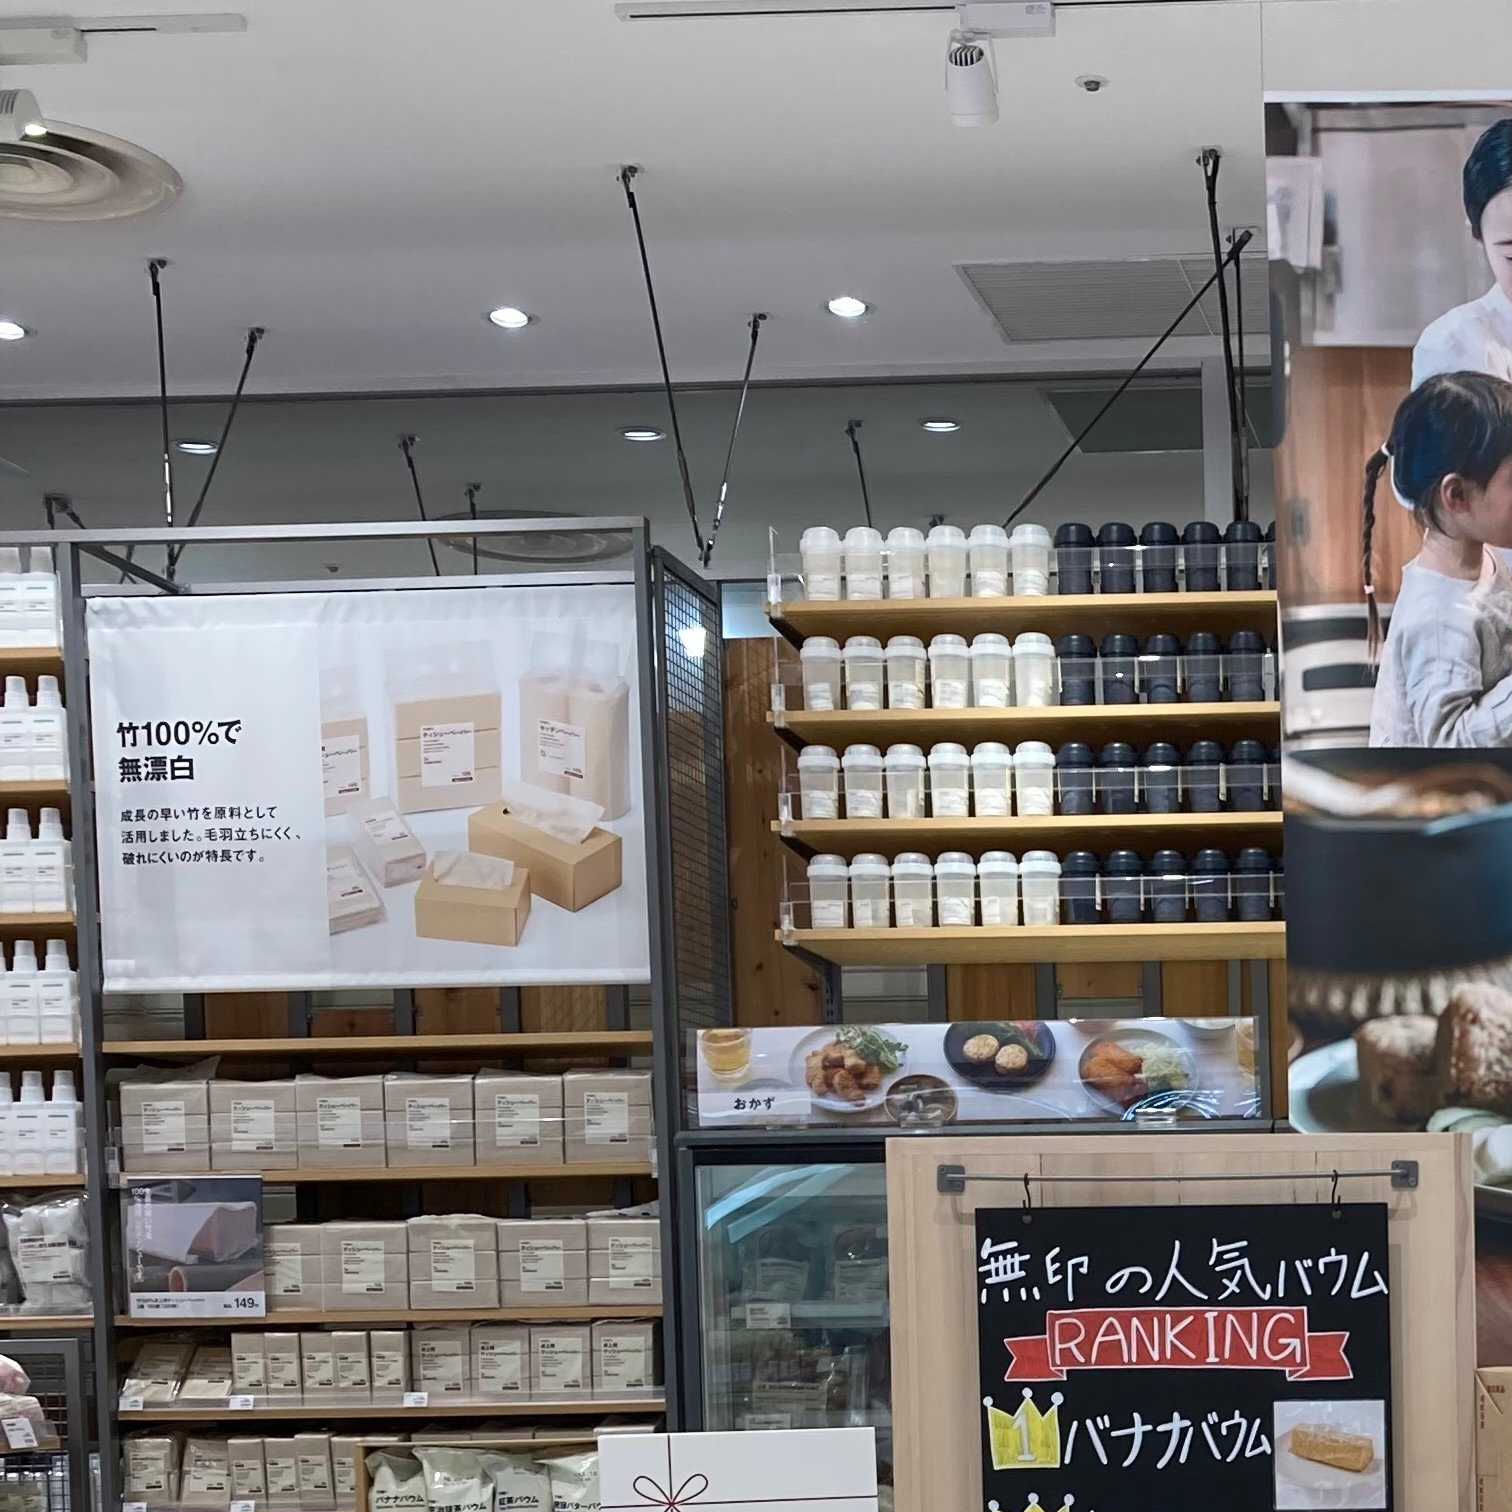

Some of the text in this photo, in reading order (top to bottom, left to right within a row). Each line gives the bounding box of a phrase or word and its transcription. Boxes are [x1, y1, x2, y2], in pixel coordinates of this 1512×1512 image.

[116, 719, 242, 748] 竹100%で
[118, 755, 194, 782] 無漂白
[120, 806, 277, 822] 成長の早い竹を原料として
[121, 826, 301, 843] 活用しました。毛羽立ちにくく、
[122, 849, 264, 865] 破れにくいのが特長です。
[734, 1097, 775, 1110] おかず
[978, 1236, 1389, 1304] 無印の人気バウム
[1052, 1311, 1305, 1365] RANKING
[1013, 1412, 1034, 1462] 1
[1064, 1411, 1272, 1470] バナナバウム
